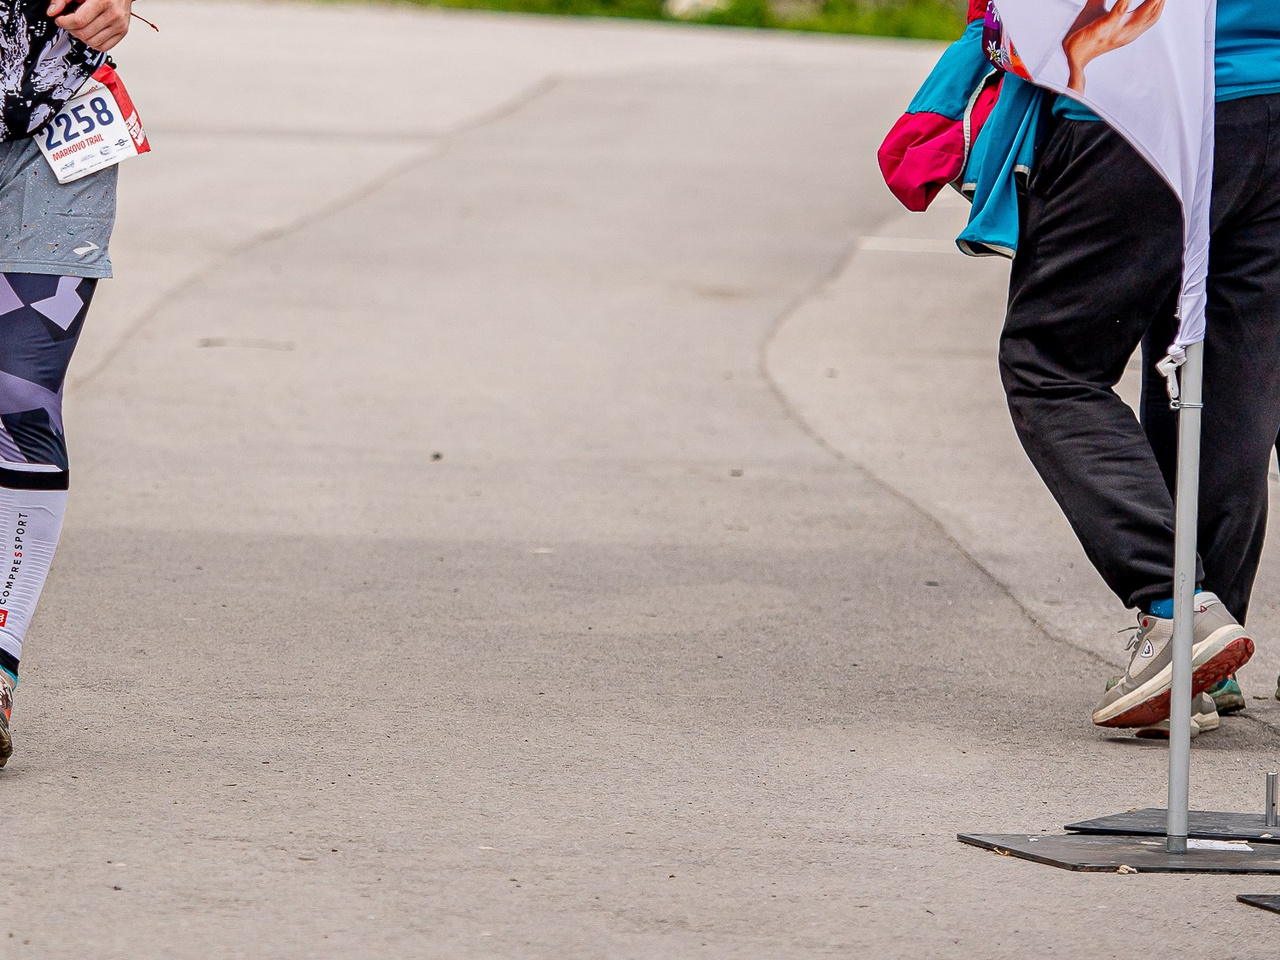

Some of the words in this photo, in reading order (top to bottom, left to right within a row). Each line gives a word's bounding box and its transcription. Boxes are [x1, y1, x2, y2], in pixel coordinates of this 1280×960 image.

[38, 96, 115, 152] 2258
[52, 141, 86, 162] MARKOVO
[85, 134, 104, 148] TRAIL
